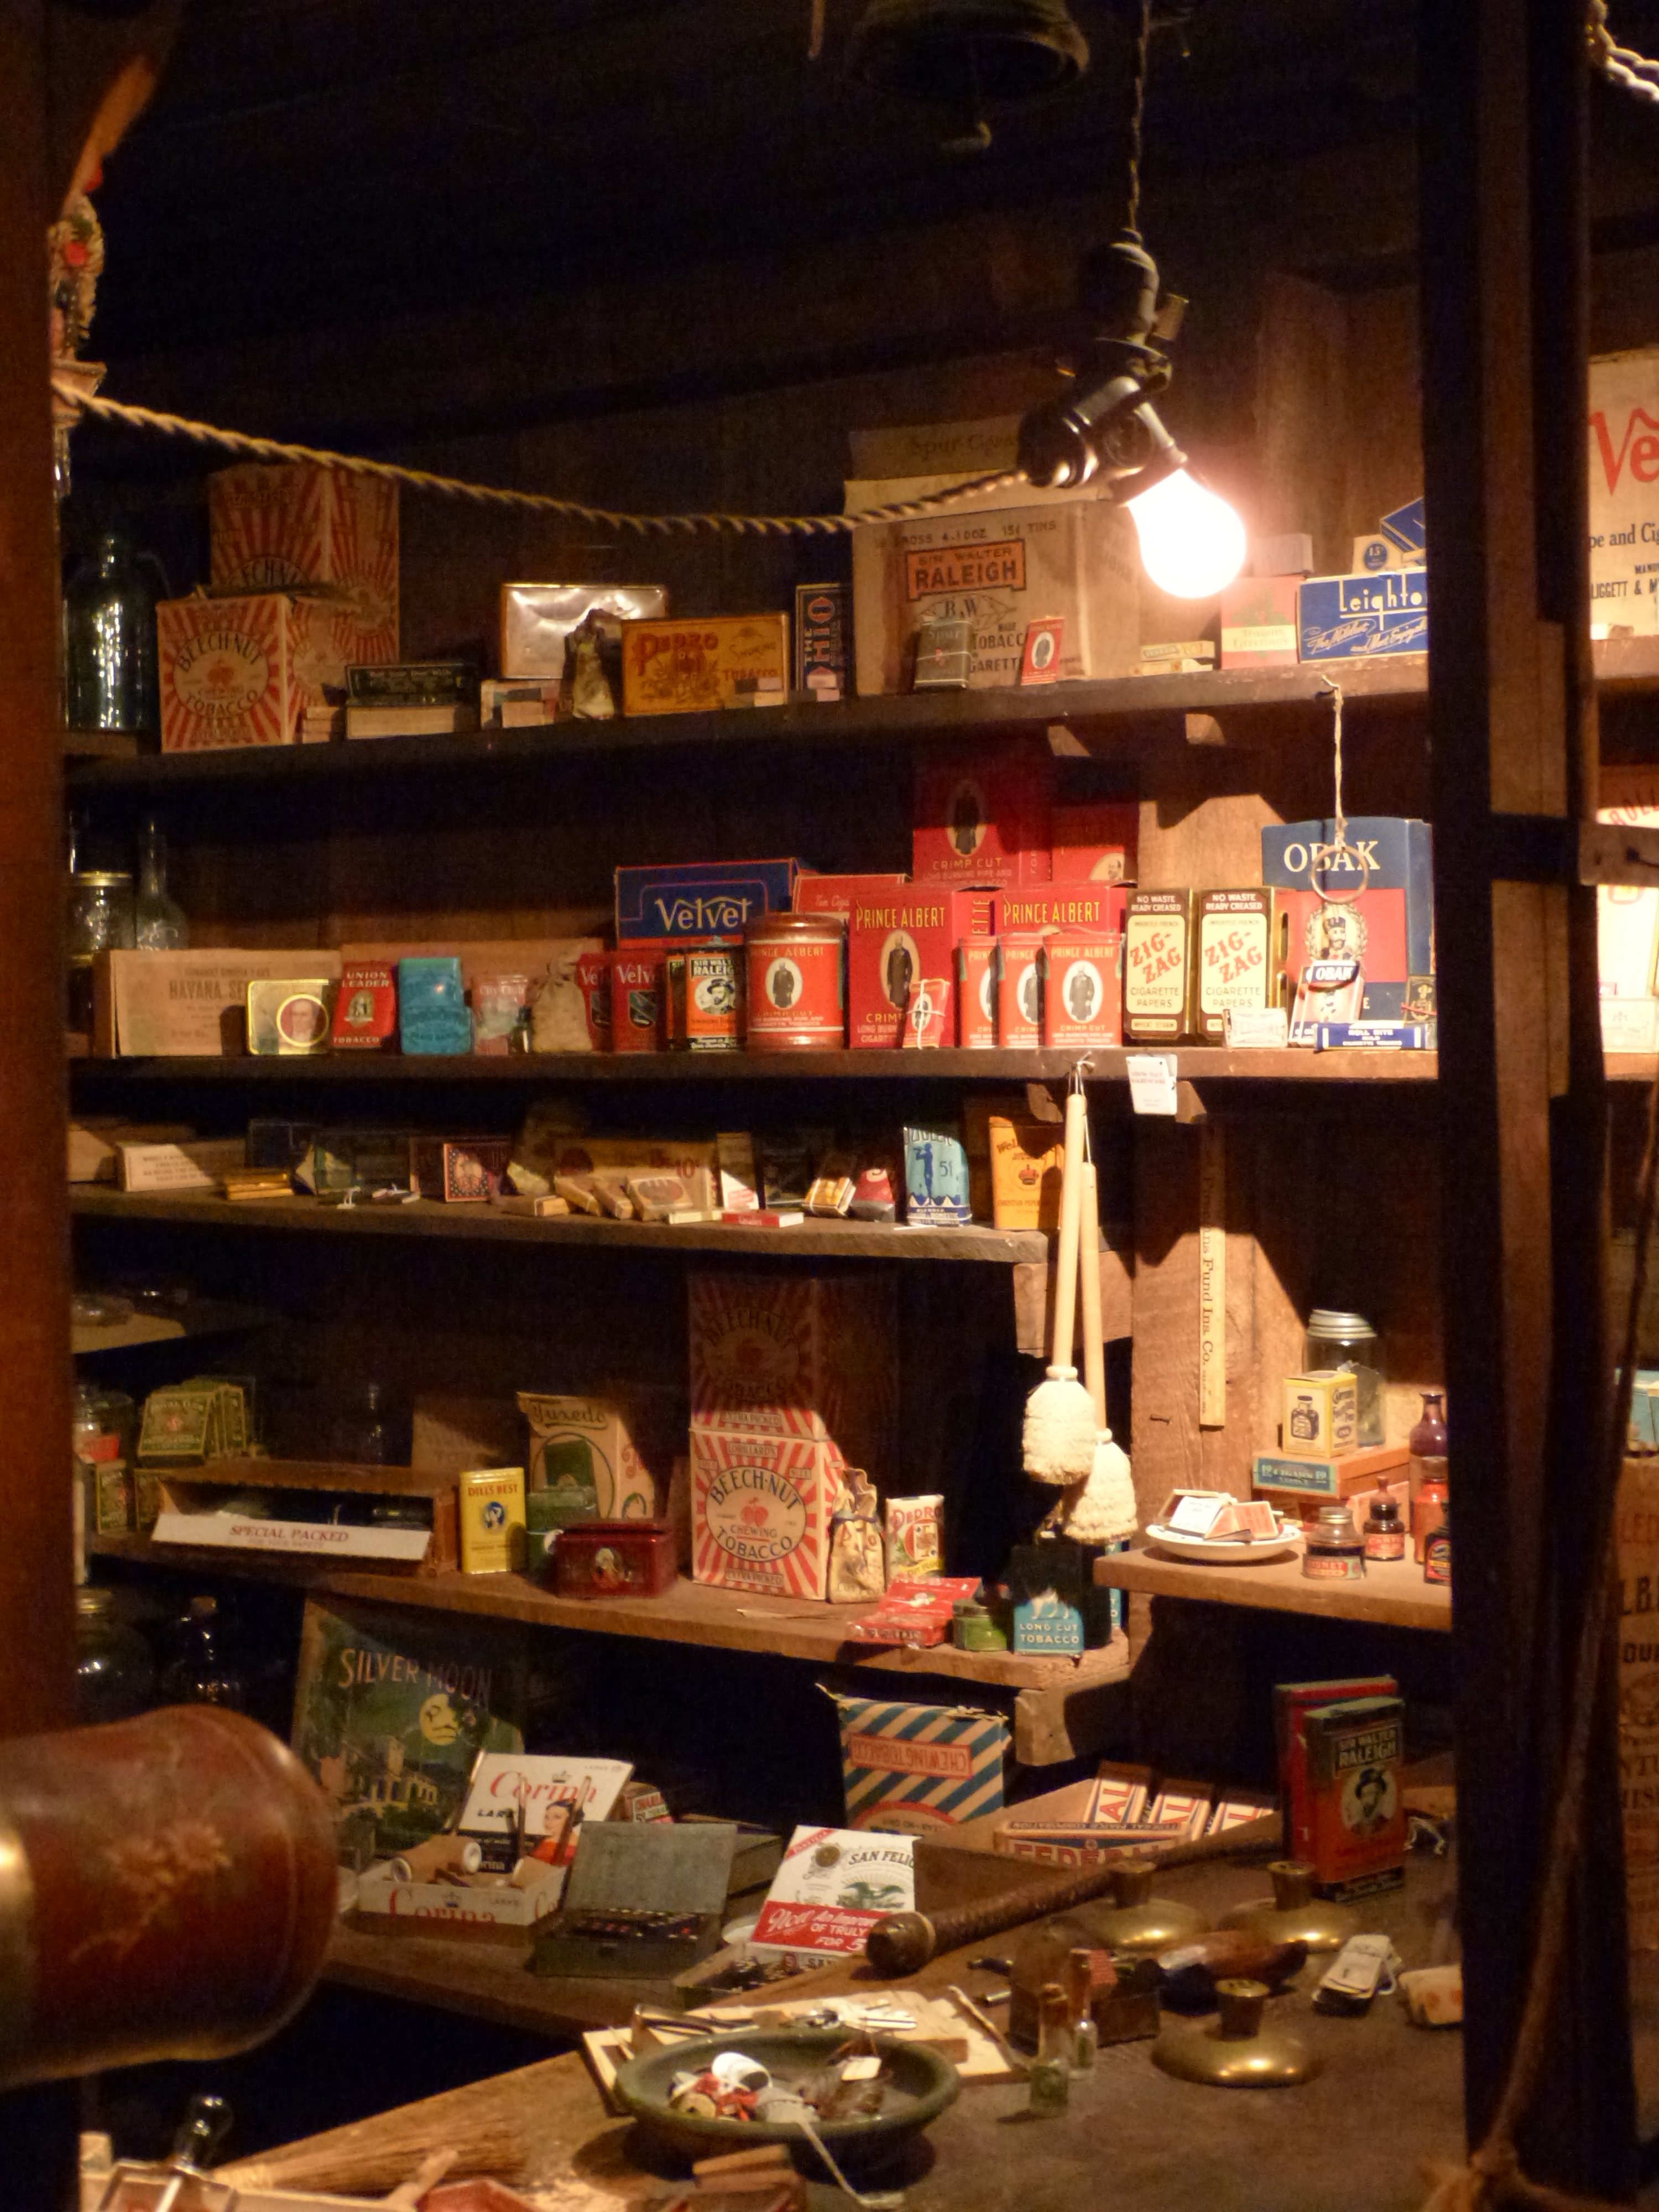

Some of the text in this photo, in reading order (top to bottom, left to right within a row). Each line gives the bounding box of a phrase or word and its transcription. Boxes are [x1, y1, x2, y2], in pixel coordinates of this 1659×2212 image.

[1027, 520, 1057, 531] TINS
[1609, 523, 1636, 546] and
[954, 546, 1013, 561] WALTER
[915, 560, 1016, 589] RALEIGH
[185, 687, 259, 716] TOBACCO
[932, 857, 1003, 870] CRIMP CUT
[1136, 895, 1176, 904] NO WASTE
[1228, 893, 1256, 902] WASTE
[654, 895, 753, 931] Velvet
[1003, 895, 1100, 926] PRINCE ALBERT
[1152, 904, 1182, 912] CREASED
[1230, 902, 1263, 911] CREASED
[856, 899, 896, 931] PRINCE
[900, 907, 945, 928] ALBERT
[1130, 932, 1171, 968] ZIG-
[1204, 931, 1251, 967] ZIG-
[1142, 947, 1182, 984] ZAG
[1219, 946, 1263, 984] ZAG
[346, 971, 388, 980] UNION
[342, 979, 389, 988] LEADER
[1130, 987, 1180, 997] CIGARETTE
[1206, 987, 1261, 996] CIGARETTE
[1136, 999, 1172, 1008] PAPERS
[1213, 998, 1253, 1008] PAPERS
[1202, 1258, 1214, 1302] Fund
[1202, 1340, 1214, 1365] Co.
[533, 1402, 606, 1424] Tuxedo
[497, 1483, 519, 1495] BEST
[229, 1525, 349, 1542] SPECIAL PACKED
[730, 1524, 778, 1538] CHEWING
[717, 1525, 793, 1559] TOBACCO
[1019, 1623, 1078, 1632] LONG CUT
[1020, 1634, 1079, 1644] TOBACCO
[338, 1647, 420, 1689] SILVER
[848, 1850, 880, 1866] SAN
[810, 1924, 868, 1938] OF TRULY
[815, 1938, 844, 1947] FOR
